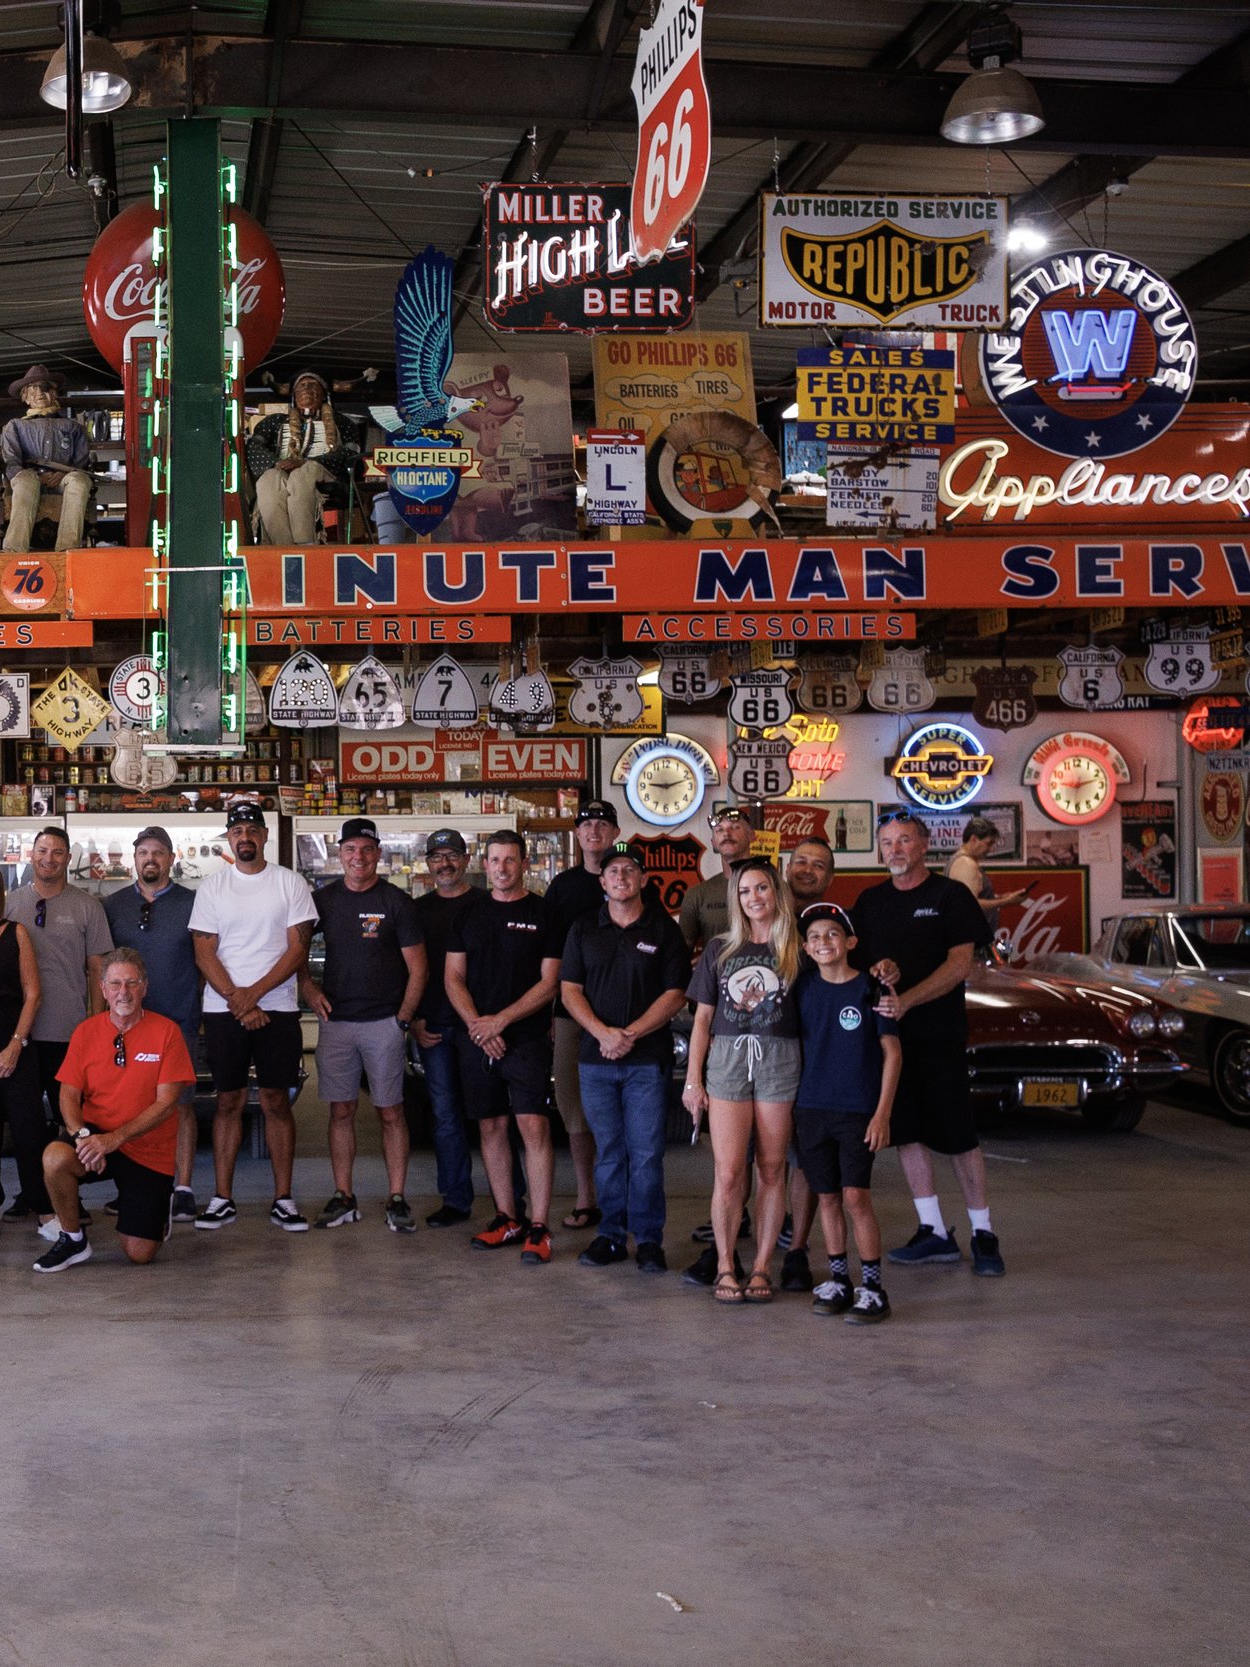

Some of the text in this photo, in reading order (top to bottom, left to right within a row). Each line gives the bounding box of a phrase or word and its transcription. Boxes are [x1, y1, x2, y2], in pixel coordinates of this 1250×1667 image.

[639, 2, 696, 105] PHILLIPS
[643, 88, 695, 226] 66
[498, 193, 603, 223] MILLER
[772, 199, 998, 219] AUTHORIZED SERVICE
[493, 227, 600, 308] HIGH
[803, 235, 970, 304] REPUBLIC
[584, 288, 681, 316] BEER
[768, 301, 1000, 323] MOTOR TRUCK
[989, 253, 1196, 400] WESTINGHOUSE
[607, 341, 738, 368] GO PHILLIPS 66
[1041, 309, 1138, 379] W
[829, 350, 925, 366] SALES
[620, 383, 678, 398] BATTERIES
[695, 380, 729, 395] TIRES
[807, 372, 948, 397] FEDERAL
[810, 397, 940, 418] TRUCKS
[815, 423, 938, 440] SERVICE
[378, 451, 470, 464] RICHFIELD
[594, 446, 638, 457] LINCOLN
[605, 464, 626, 491] L
[831, 478, 889, 488] BARSTOW
[939, 437, 1250, 522] Appliances
[594, 500, 638, 510] HIGHWAY
[831, 501, 885, 510] NEEDLES
[13, 568, 45, 595] 76
[693, 548, 926, 603] MAN
[256, 619, 477, 643] BATTERIES
[636, 616, 904, 641] ACCESSORIES
[1067, 653, 1116, 663] CALIFORNIA
[116, 662, 136, 682] STATE
[578, 665, 635, 676] CALIFORNIA
[1160, 658, 1205, 686] 99
[136, 677, 150, 700] 3
[279, 679, 328, 706] 120
[355, 681, 389, 709] 65
[438, 679, 452, 707] 7
[672, 672, 708, 695] 66
[884, 683, 921, 705] 66
[1083, 679, 1101, 702] 6
[35, 692, 56, 712] THE
[81, 686, 106, 714] STATE
[500, 682, 545, 712] 49
[812, 684, 848, 708] 66
[62, 696, 81, 724] 3
[273, 711, 297, 719] STATE
[301, 711, 335, 719] HIGHWAY
[416, 710, 475, 719] STATE HIGHWAY
[742, 699, 779, 722] 66
[985, 700, 1028, 723] 466
[47, 718, 95, 739] HIGHWAY
[447, 731, 485, 741] TODAY
[785, 714, 839, 747] Soto
[917, 729, 966, 746] SUPER
[352, 745, 434, 774] ODD
[488, 742, 580, 771] EVEN
[736, 743, 788, 755] NEW MEXICO
[125, 760, 165, 783] 65
[347, 771, 440, 782] License plates today only
[488, 769, 582, 781] License plates today only
[901, 760, 985, 773] CHEVROLET
[742, 770, 779, 794] 66
[912, 781, 972, 805] SERVICE
[1035, 1088, 1068, 1103] 1962
